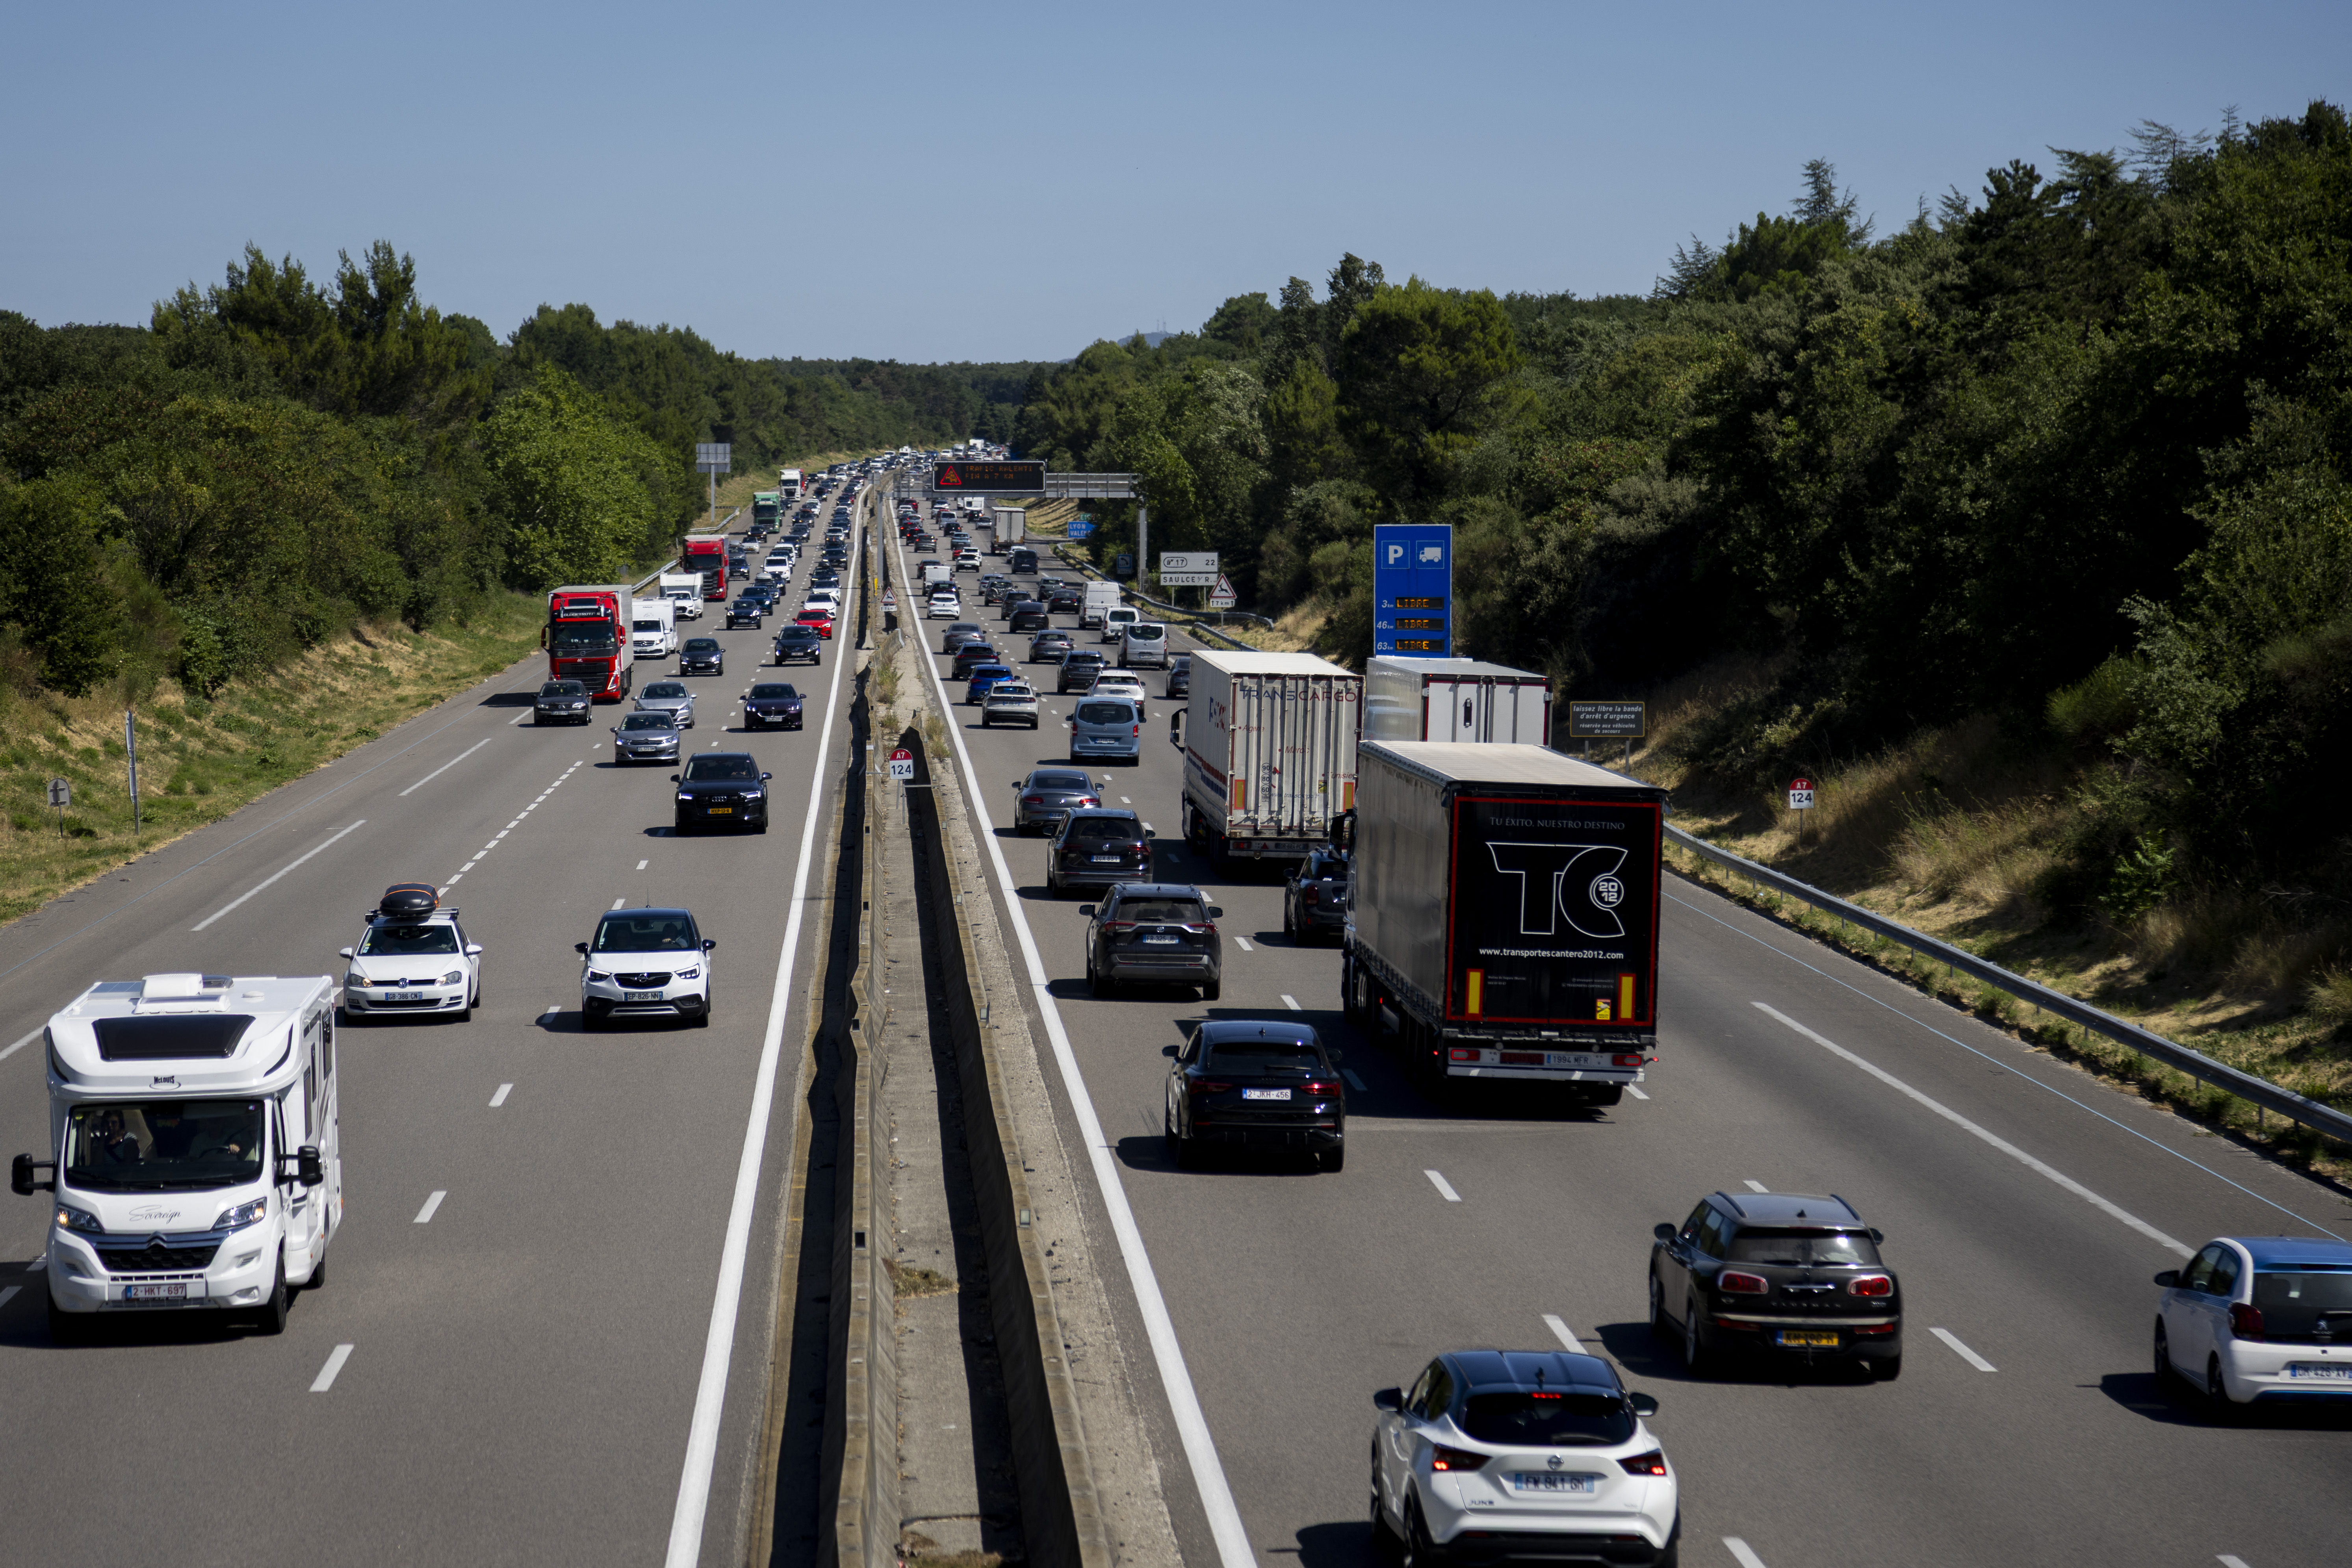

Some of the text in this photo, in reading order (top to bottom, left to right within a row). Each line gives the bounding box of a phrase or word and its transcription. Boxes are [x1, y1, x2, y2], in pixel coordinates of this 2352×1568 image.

[1397, 599, 1429, 607] LIBRE
[1397, 620, 1429, 628] LIBRE
[1397, 641, 1429, 649] LIBRE
[1240, 689, 1357, 702] TRANSCARGO
[891, 764, 912, 775] 124
[1791, 792, 1812, 803] 124
[1537, 820, 1582, 829] NUESTRO
[1584, 821, 1625, 830] DESTINO
[1598, 882, 1618, 892] 20
[1601, 892, 1618, 902] 12
[1479, 948, 1624, 959] www.transportescantero2012.com
[129, 1204, 181, 1225] Sovereign
